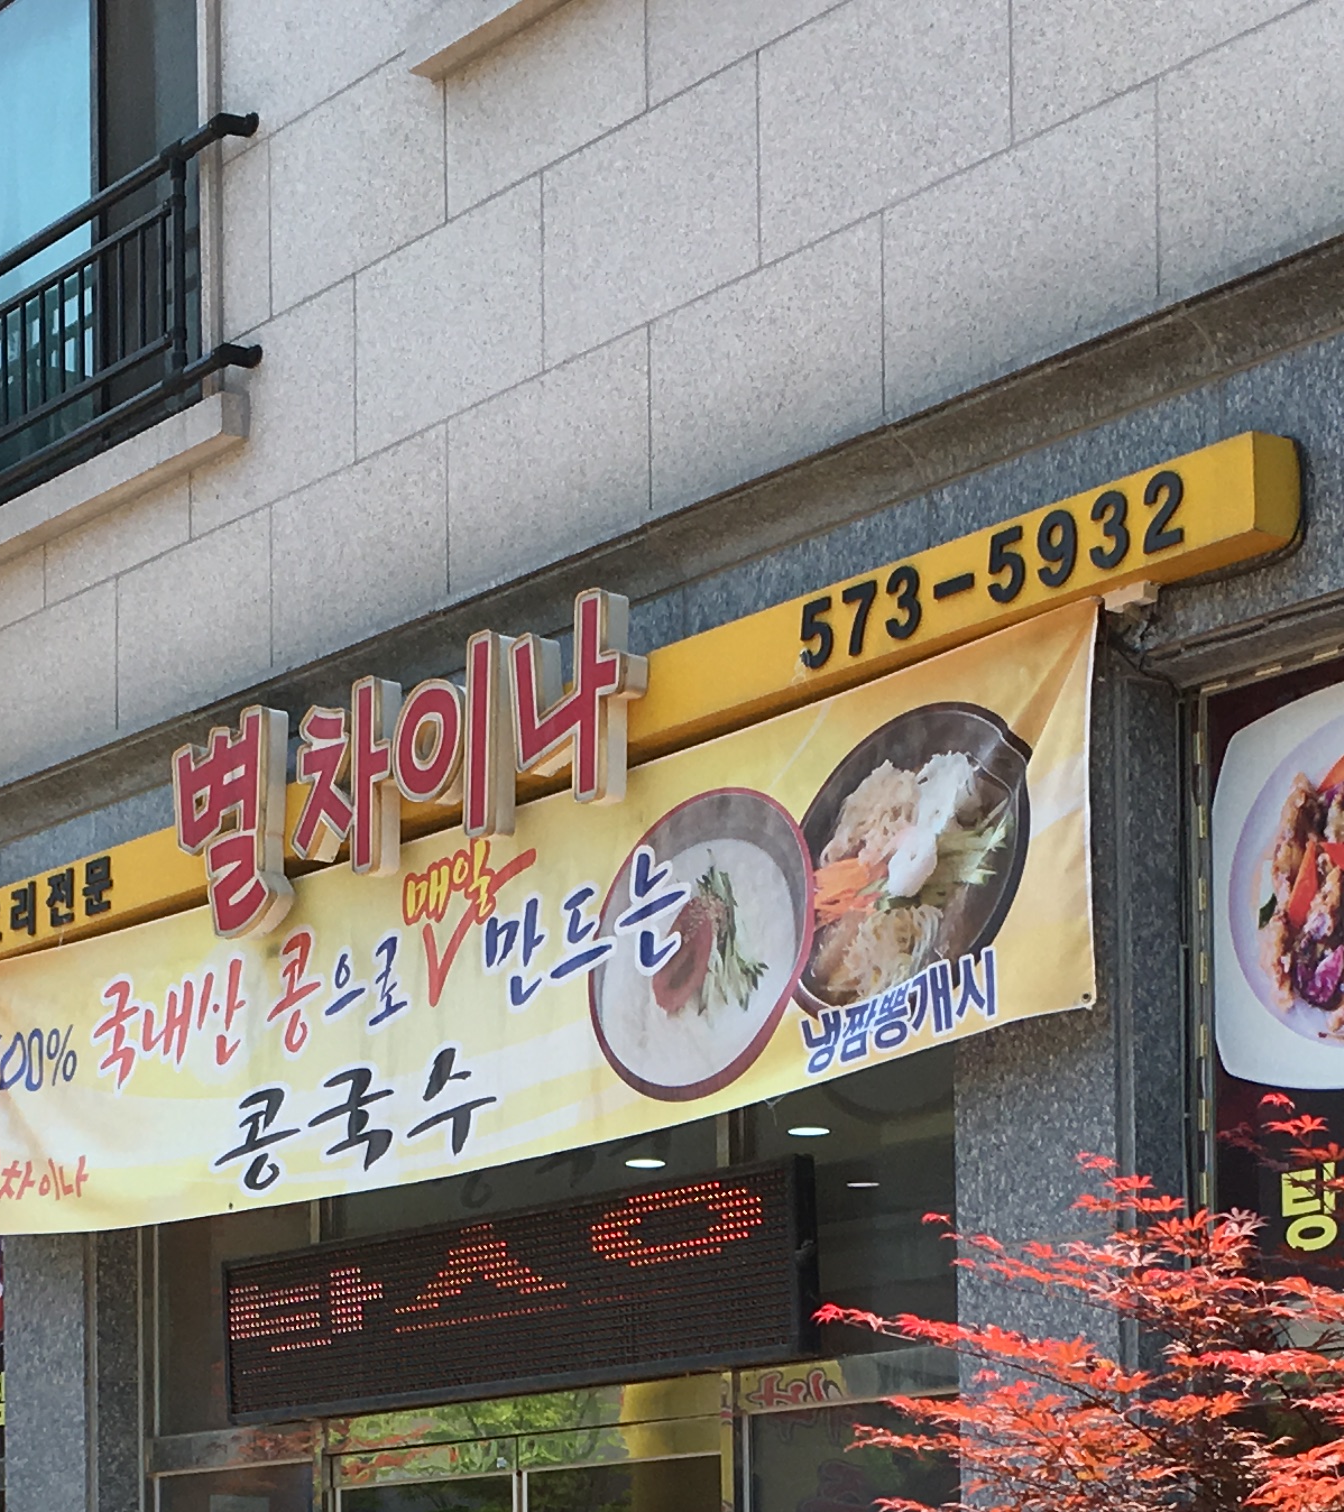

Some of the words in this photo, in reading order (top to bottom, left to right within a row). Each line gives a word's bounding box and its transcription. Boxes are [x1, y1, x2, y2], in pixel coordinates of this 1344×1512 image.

[800, 469, 1186, 669] 573-5932
[172, 588, 646, 940] 별차이나
[93, 958, 248, 1090] 국내산
[267, 931, 410, 1055] 콩으로
[484, 845, 692, 1006] 만드는
[214, 1046, 498, 1191] 콩국수
